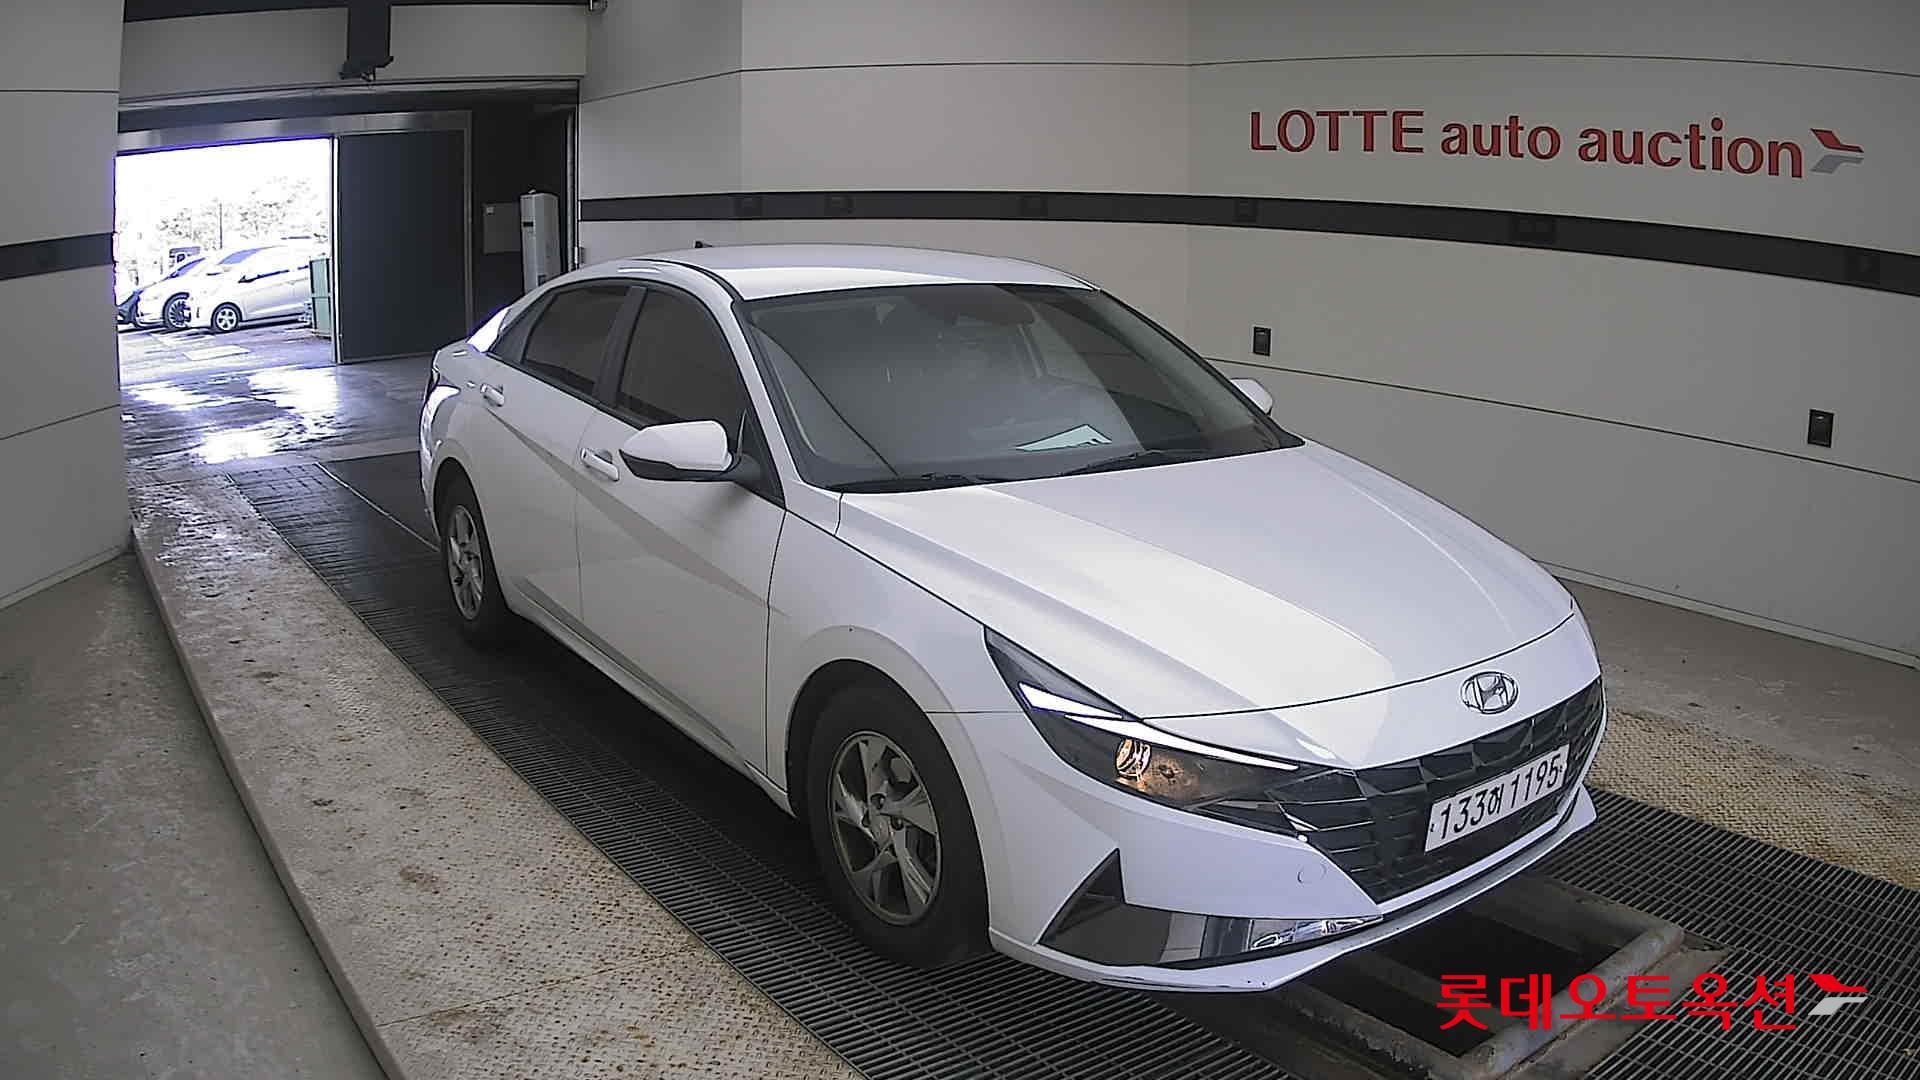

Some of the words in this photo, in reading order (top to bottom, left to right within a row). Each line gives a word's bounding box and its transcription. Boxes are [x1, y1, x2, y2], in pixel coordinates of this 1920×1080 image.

[1250, 110, 1424, 154] LOTTE
[1440, 116, 1563, 160] auto
[1577, 117, 1803, 179] auction
[1510, 753, 1561, 809] 1195
